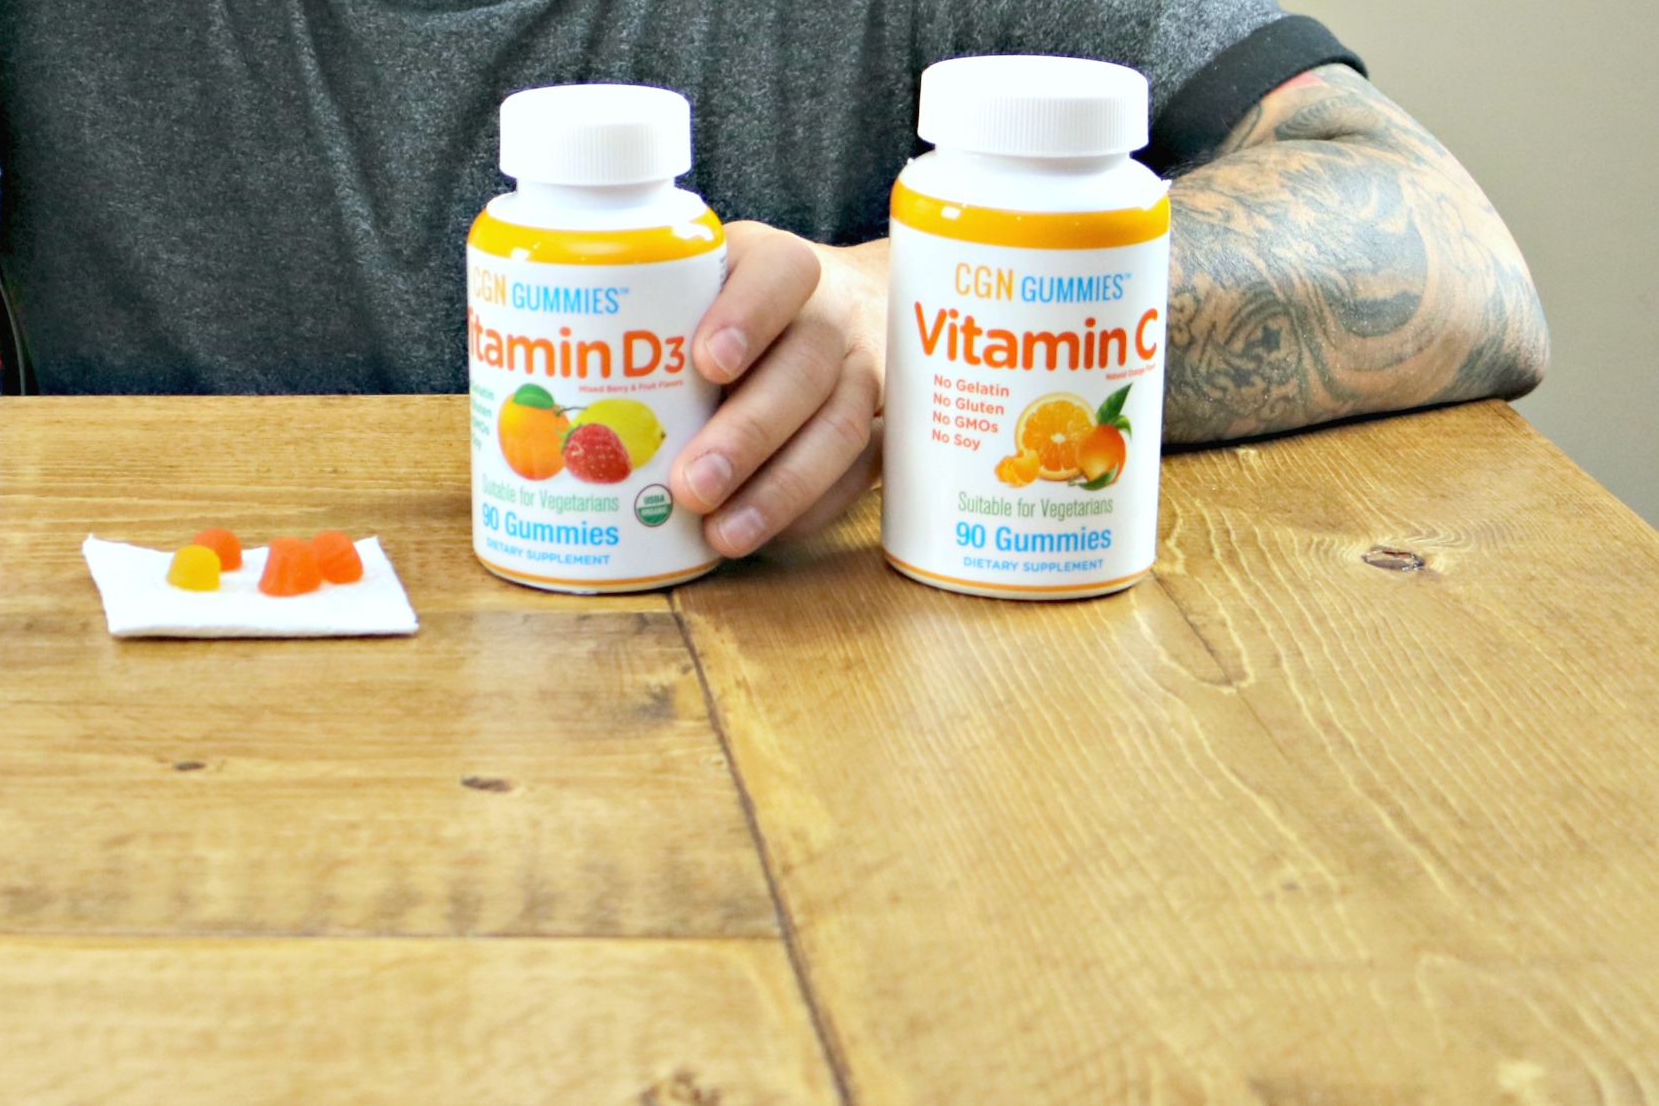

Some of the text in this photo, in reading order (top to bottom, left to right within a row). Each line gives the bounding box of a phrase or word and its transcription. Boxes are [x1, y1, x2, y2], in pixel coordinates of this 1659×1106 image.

[955, 263, 1013, 302] CGN
[914, 301, 1158, 371] Vitamin C
[623, 330, 686, 378] D3
[933, 374, 1010, 397] No Gelatin
[933, 392, 1005, 415] No Gluten
[932, 410, 999, 433] No GMOs
[932, 429, 981, 451] No Soy
[482, 473, 619, 514] Suitable for Vegetarians
[958, 492, 1113, 522] Suitable for Vegetarians
[482, 503, 619, 546] 90 Gummies
[955, 522, 1111, 553] 90 Gummies
[486, 537, 610, 565] DIETARY SUPPLEMENT
[963, 557, 1104, 573] DIETARY SUPPLEMENT
